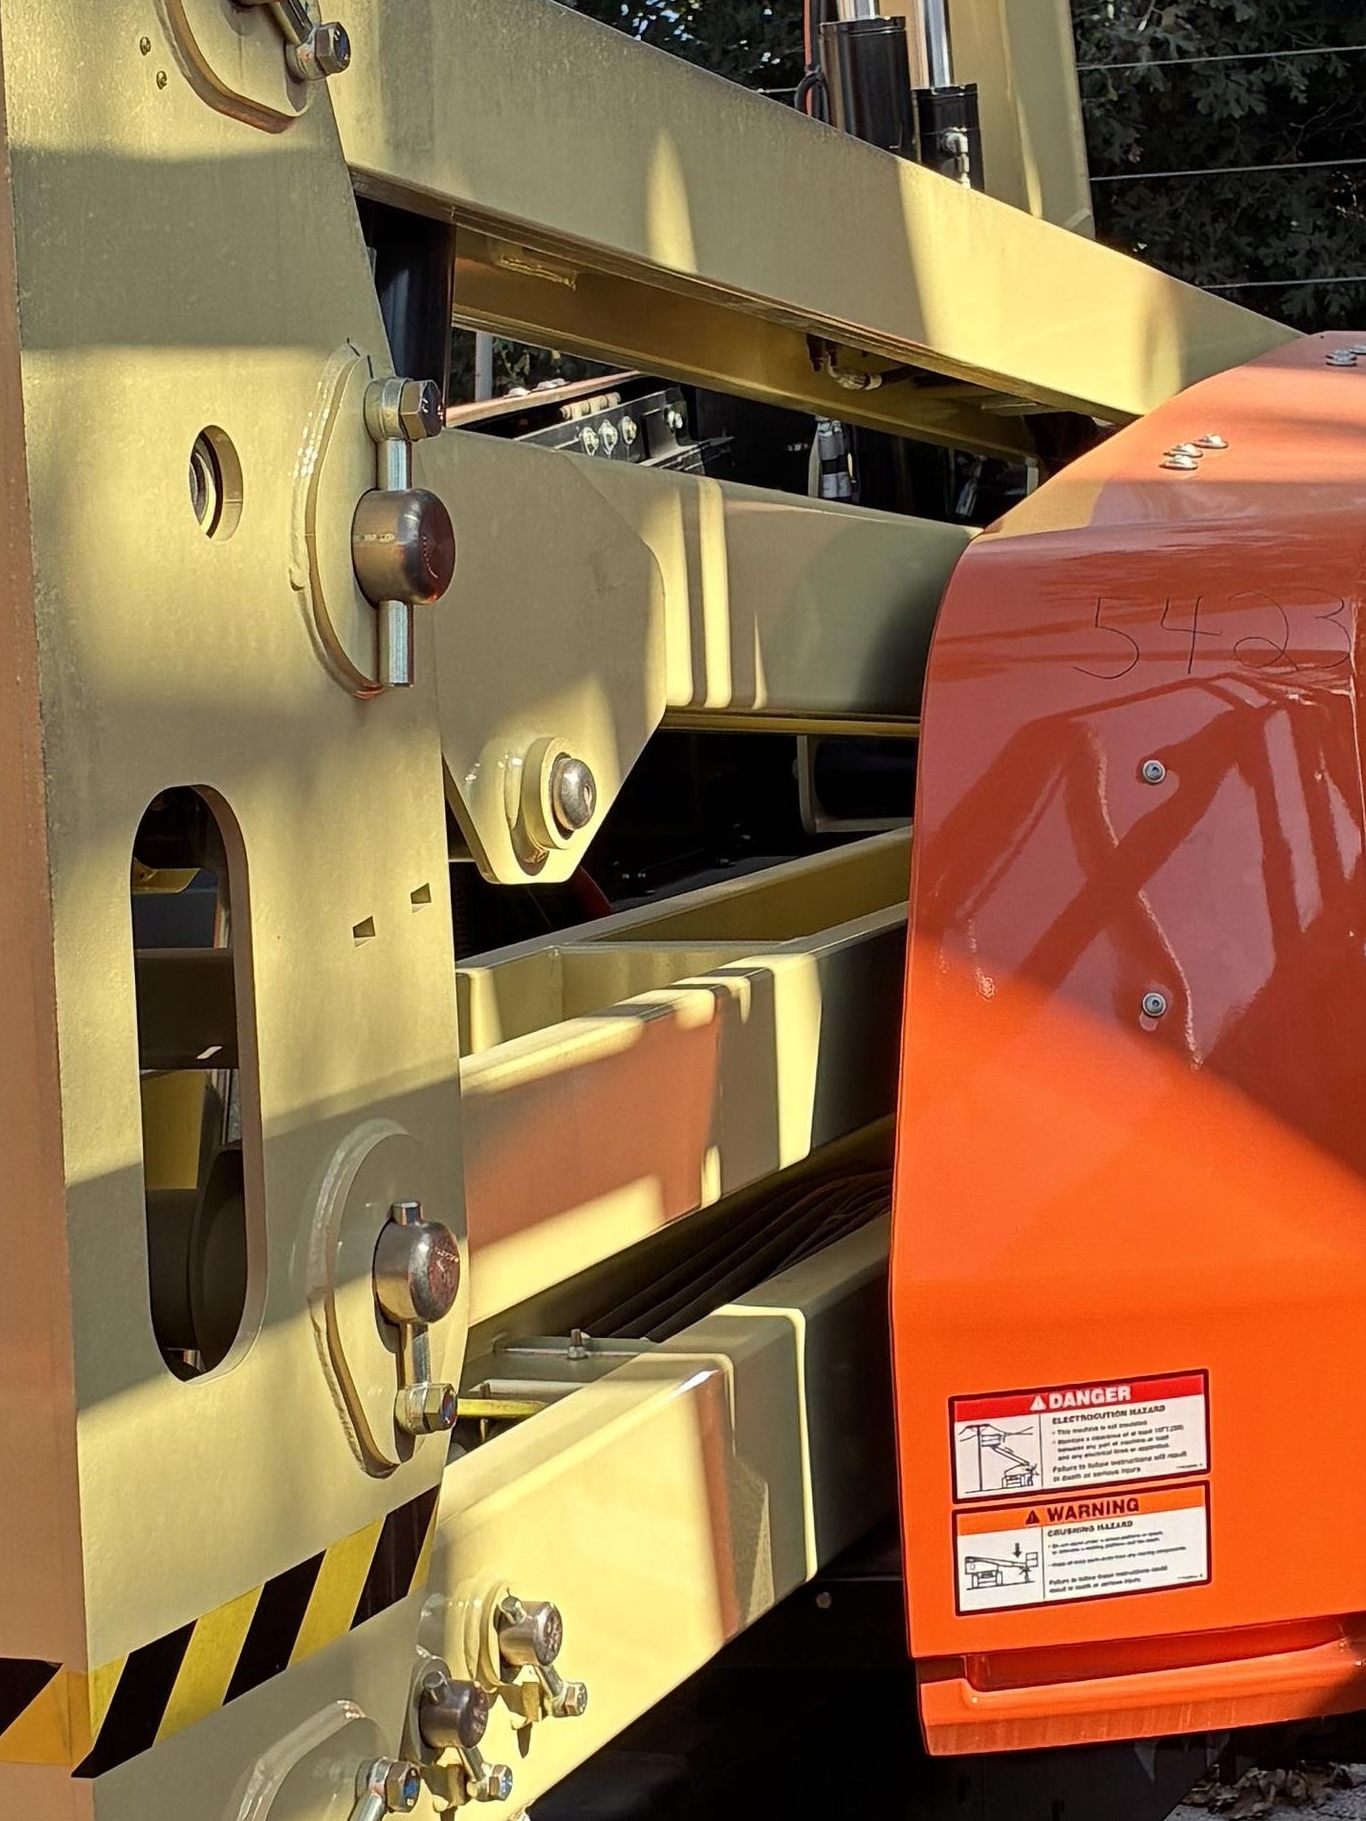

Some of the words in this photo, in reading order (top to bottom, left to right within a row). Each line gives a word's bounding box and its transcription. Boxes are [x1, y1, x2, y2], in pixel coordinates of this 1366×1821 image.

[1070, 586, 1352, 680] 5423
[1049, 1386, 1132, 1410] DANGER
[1048, 1498, 1139, 1522] WARNING
